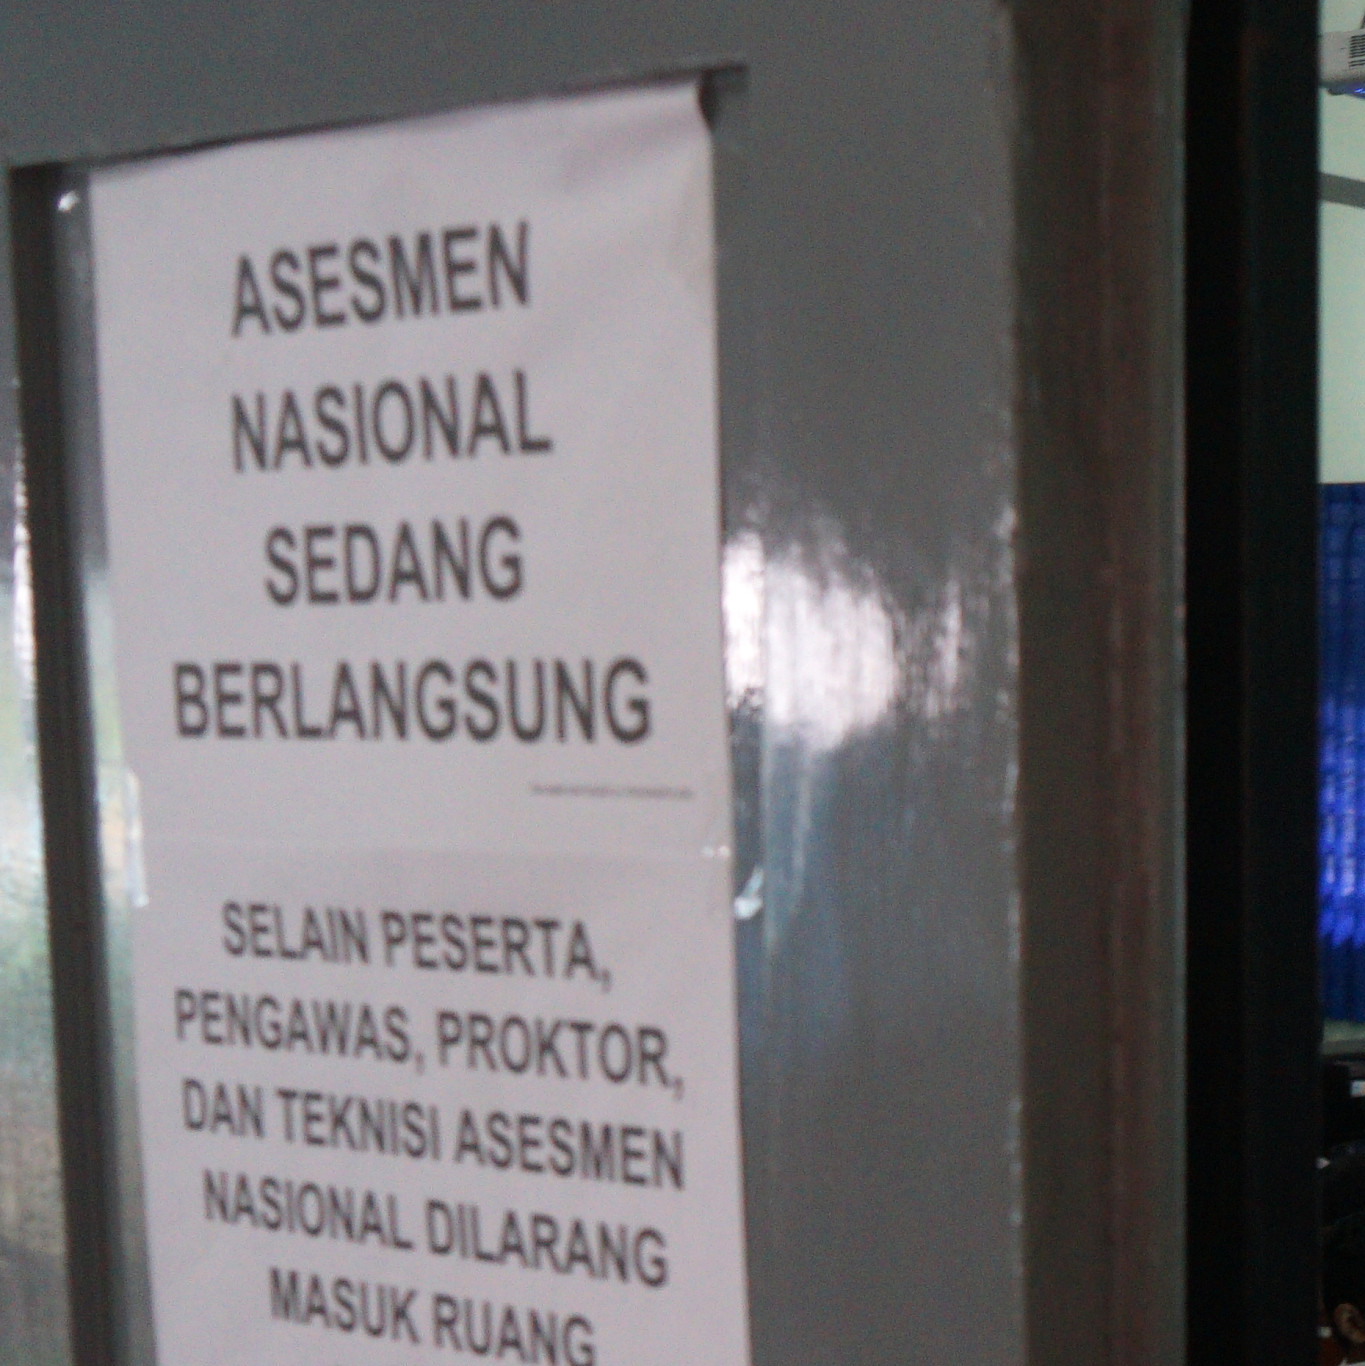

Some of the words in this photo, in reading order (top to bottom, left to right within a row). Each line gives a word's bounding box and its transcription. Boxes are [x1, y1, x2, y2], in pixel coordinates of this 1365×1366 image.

[230, 219, 531, 339] ASESMEN
[231, 369, 554, 474] NASIONAL
[265, 516, 524, 605] SEDANG
[172, 657, 652, 745] BERLANGSUNG
[222, 902, 370, 964] SELAIN
[382, 911, 611, 992] PESERTA,
[173, 988, 425, 1074] PENGAWAS,
[436, 1009, 685, 1099] PROKTOR,
[181, 1078, 264, 1138] DAN
[277, 1087, 440, 1161] TEKNISI
[453, 1110, 686, 1191] ASESMEN
[201, 1168, 412, 1250] NASIONAL
[424, 1198, 668, 1289] DILARANG
[269, 1266, 421, 1346] MASUK
